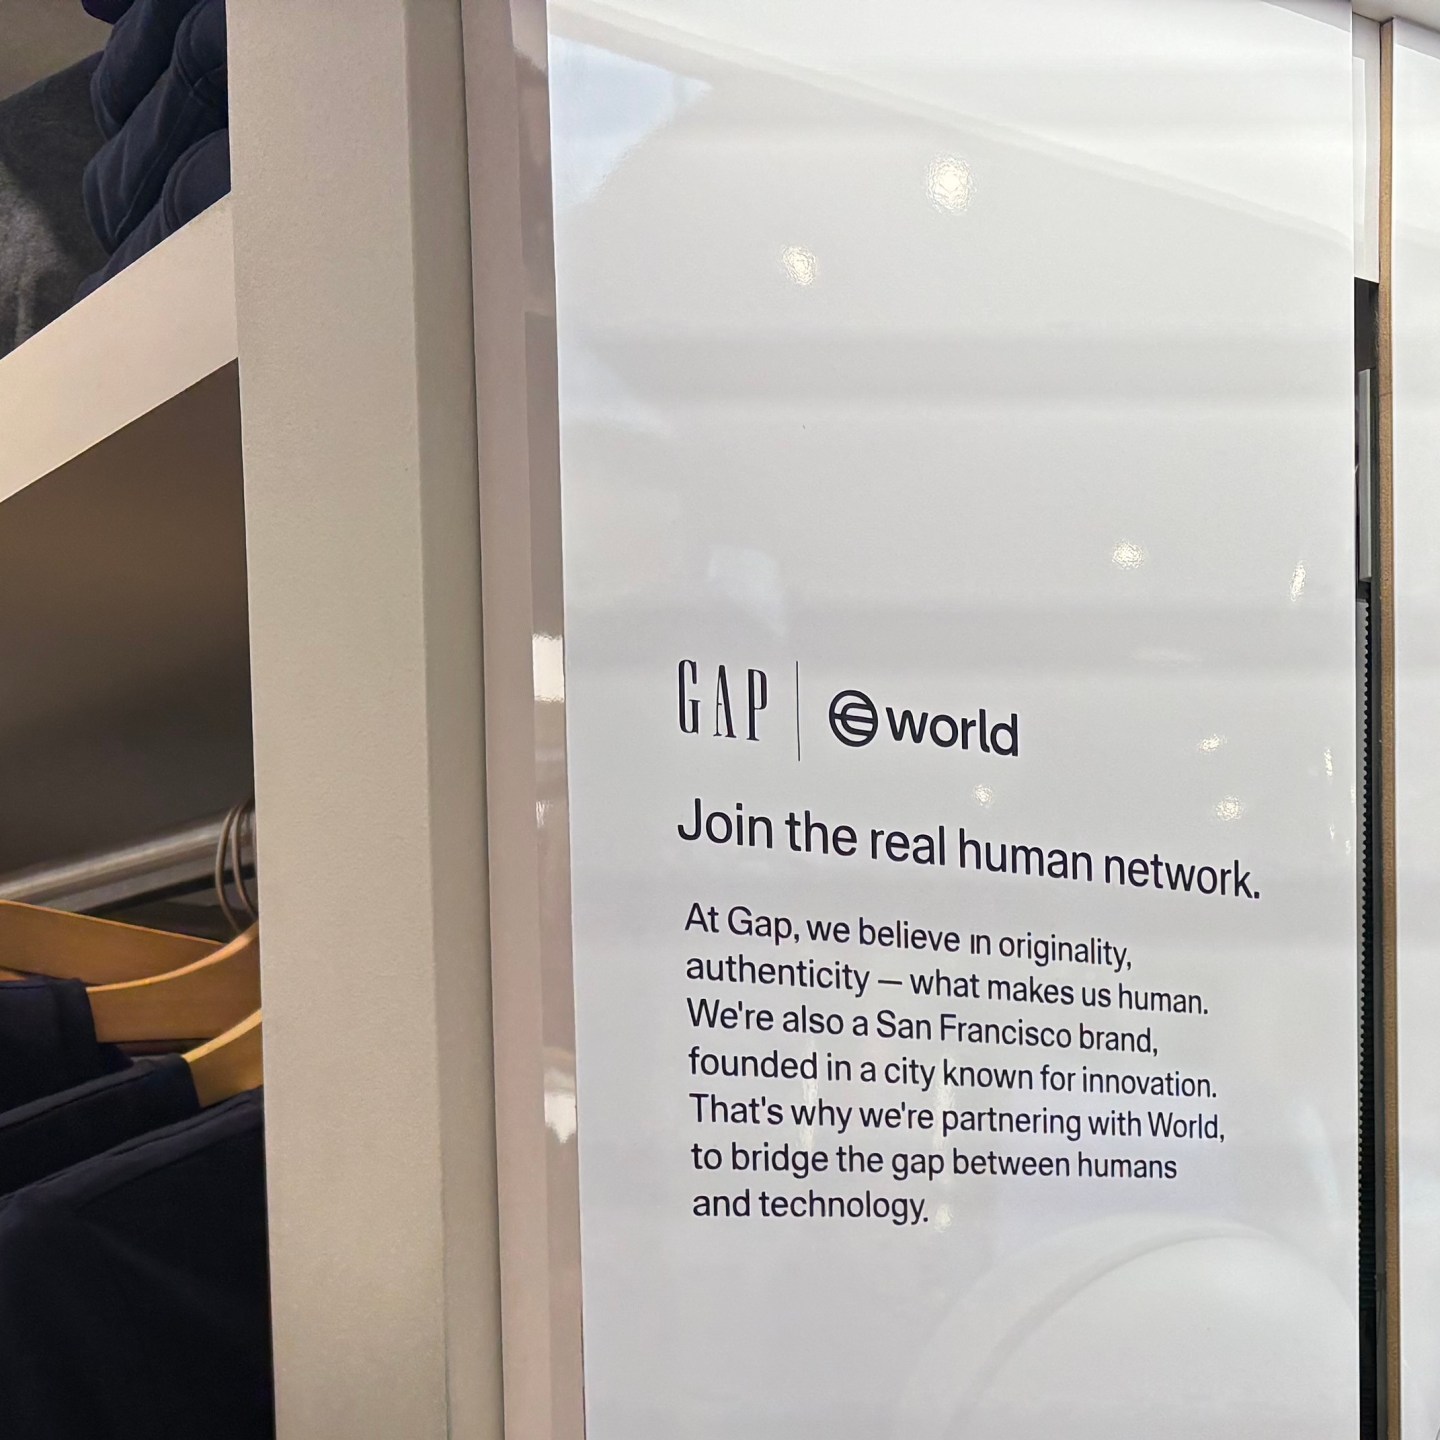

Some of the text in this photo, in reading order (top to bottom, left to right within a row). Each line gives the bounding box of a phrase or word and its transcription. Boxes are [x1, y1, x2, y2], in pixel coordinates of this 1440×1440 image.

[677, 659, 1019, 758] GAP world
[677, 797, 1260, 900] Join the real human network.
[684, 902, 1132, 974] At Gap, we believe in originality,
[686, 953, 871, 999] authenticity
[909, 968, 981, 999] what
[987, 975, 1075, 1006] makes
[1081, 986, 1112, 1008] us
[1118, 982, 1209, 1015] human.
[686, 997, 1158, 1058] We're also a San Francisco brand,
[687, 1045, 1217, 1099] founded in a city known for innovation.
[688, 1092, 1225, 1144] That's why we're partnering with World,
[690, 1141, 1178, 1182] to bridge the gap between humans
[692, 1188, 929, 1226] and technology.
